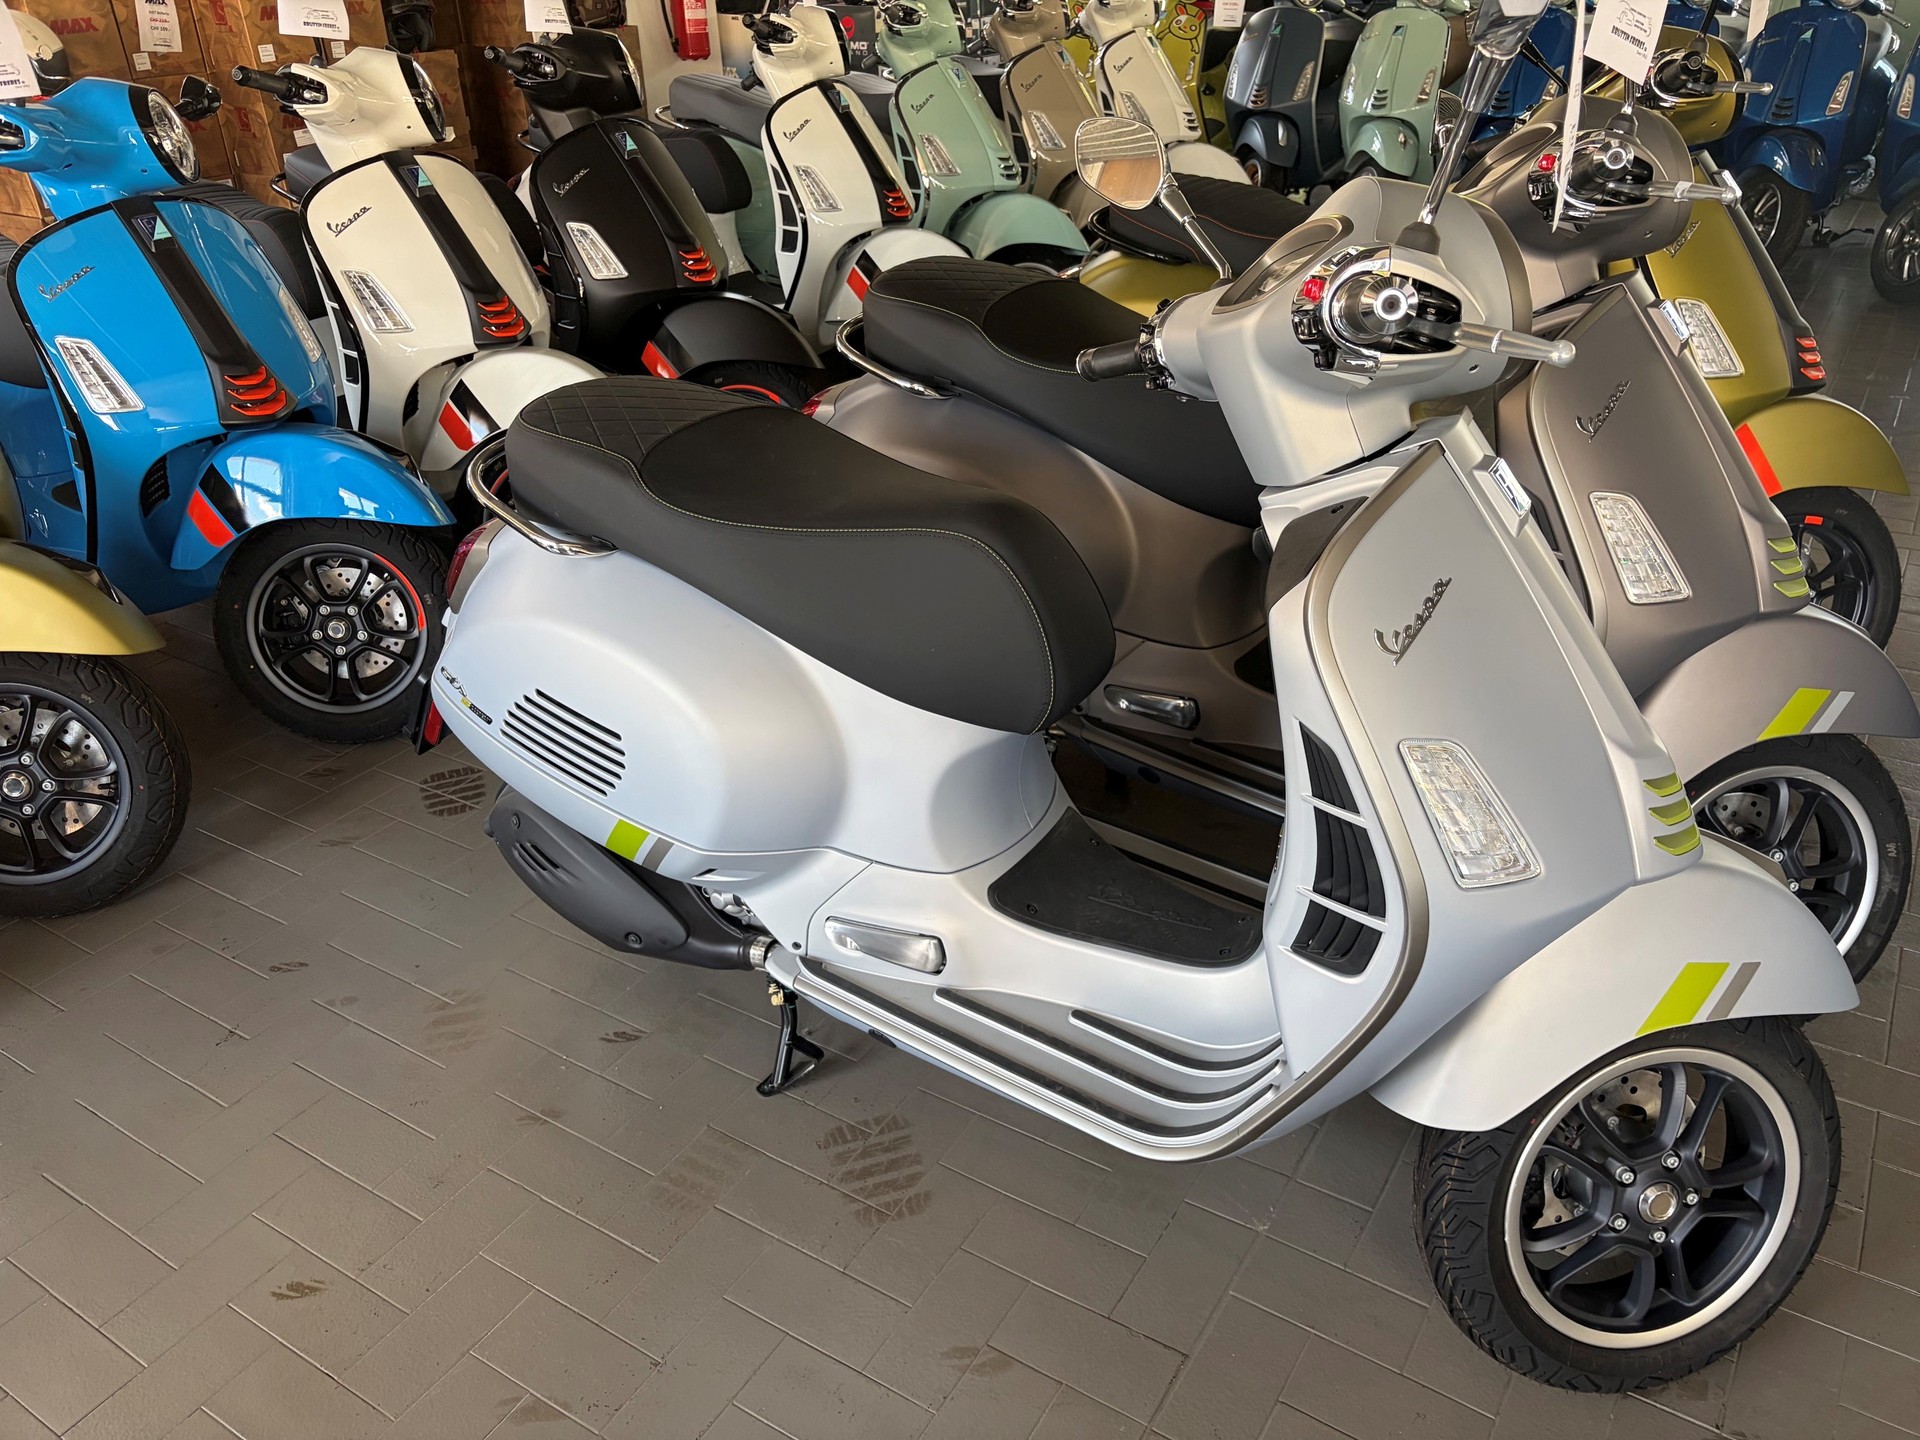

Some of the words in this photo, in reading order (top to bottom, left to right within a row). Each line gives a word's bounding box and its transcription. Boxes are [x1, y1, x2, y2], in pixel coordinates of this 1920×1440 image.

[911, 93, 935, 114] Vespa
[782, 118, 812, 142] Vespa
[552, 168, 590, 197] Vespa
[326, 206, 372, 238] Vespa
[38, 266, 96, 303] Vespa
[1575, 379, 1631, 443] Vespa
[1373, 576, 1452, 667] Vespa
